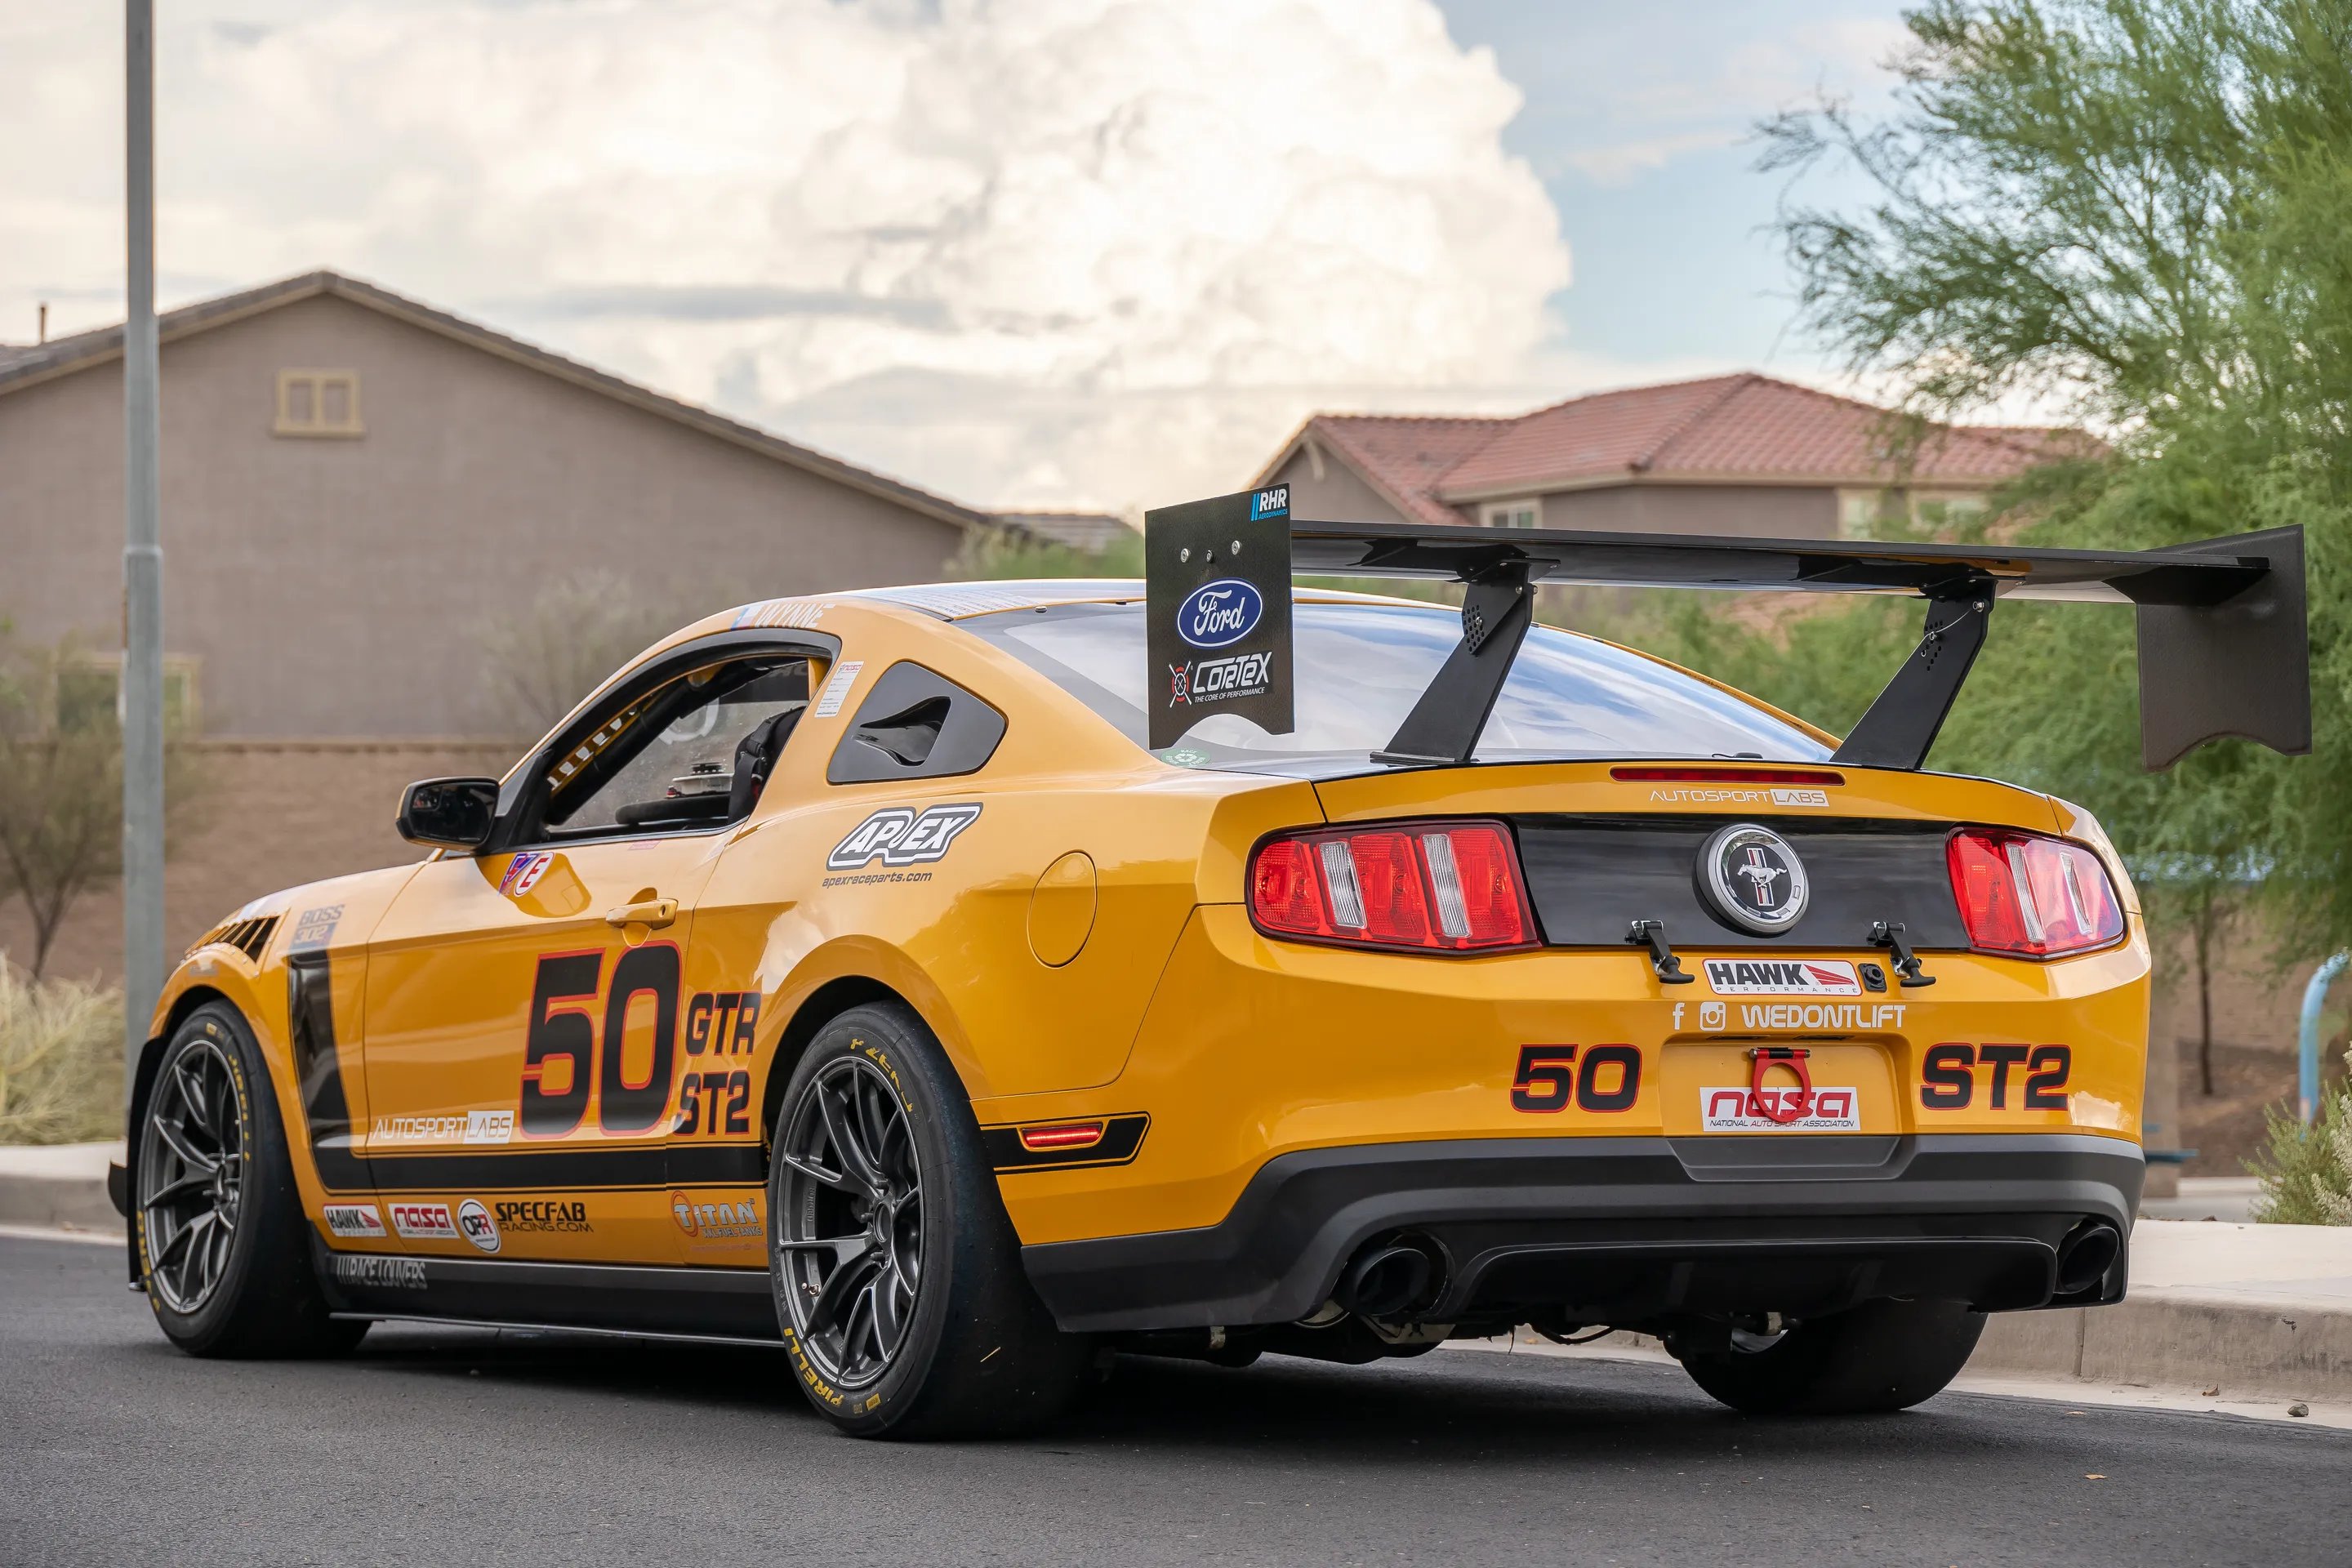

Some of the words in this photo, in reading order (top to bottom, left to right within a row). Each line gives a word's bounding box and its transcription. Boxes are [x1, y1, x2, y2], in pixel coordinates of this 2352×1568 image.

[1259, 488, 1287, 512] RHR
[755, 604, 835, 628] WYNNE
[1193, 589, 1245, 636] Ford
[1227, 687, 1266, 698] PERFORMANCE
[822, 871, 933, 889] apexraceparts.com
[298, 903, 345, 927] BOSS
[293, 925, 328, 945] 302
[1708, 963, 1810, 986] HAWK
[685, 991, 763, 1057] GTR
[1741, 1004, 1906, 1029] WEDONTLIFT
[519, 939, 683, 1140] 50
[1510, 1043, 1642, 1114] 50
[1919, 1042, 2072, 1111] ST2
[671, 1069, 751, 1137] ST2
[326, 1209, 366, 1229] HAWK
[394, 1207, 451, 1228] nasa
[495, 1201, 586, 1222] SPECFAB
[674, 1201, 760, 1227] TITAN
[461, 1214, 493, 1236] OPR
[497, 1222, 595, 1232] RACING.COM
[702, 1227, 719, 1238] XXL
[719, 1227, 739, 1237] FUEL
[737, 1226, 764, 1236] TANKS
[783, 1327, 845, 1407] PIRELLI
